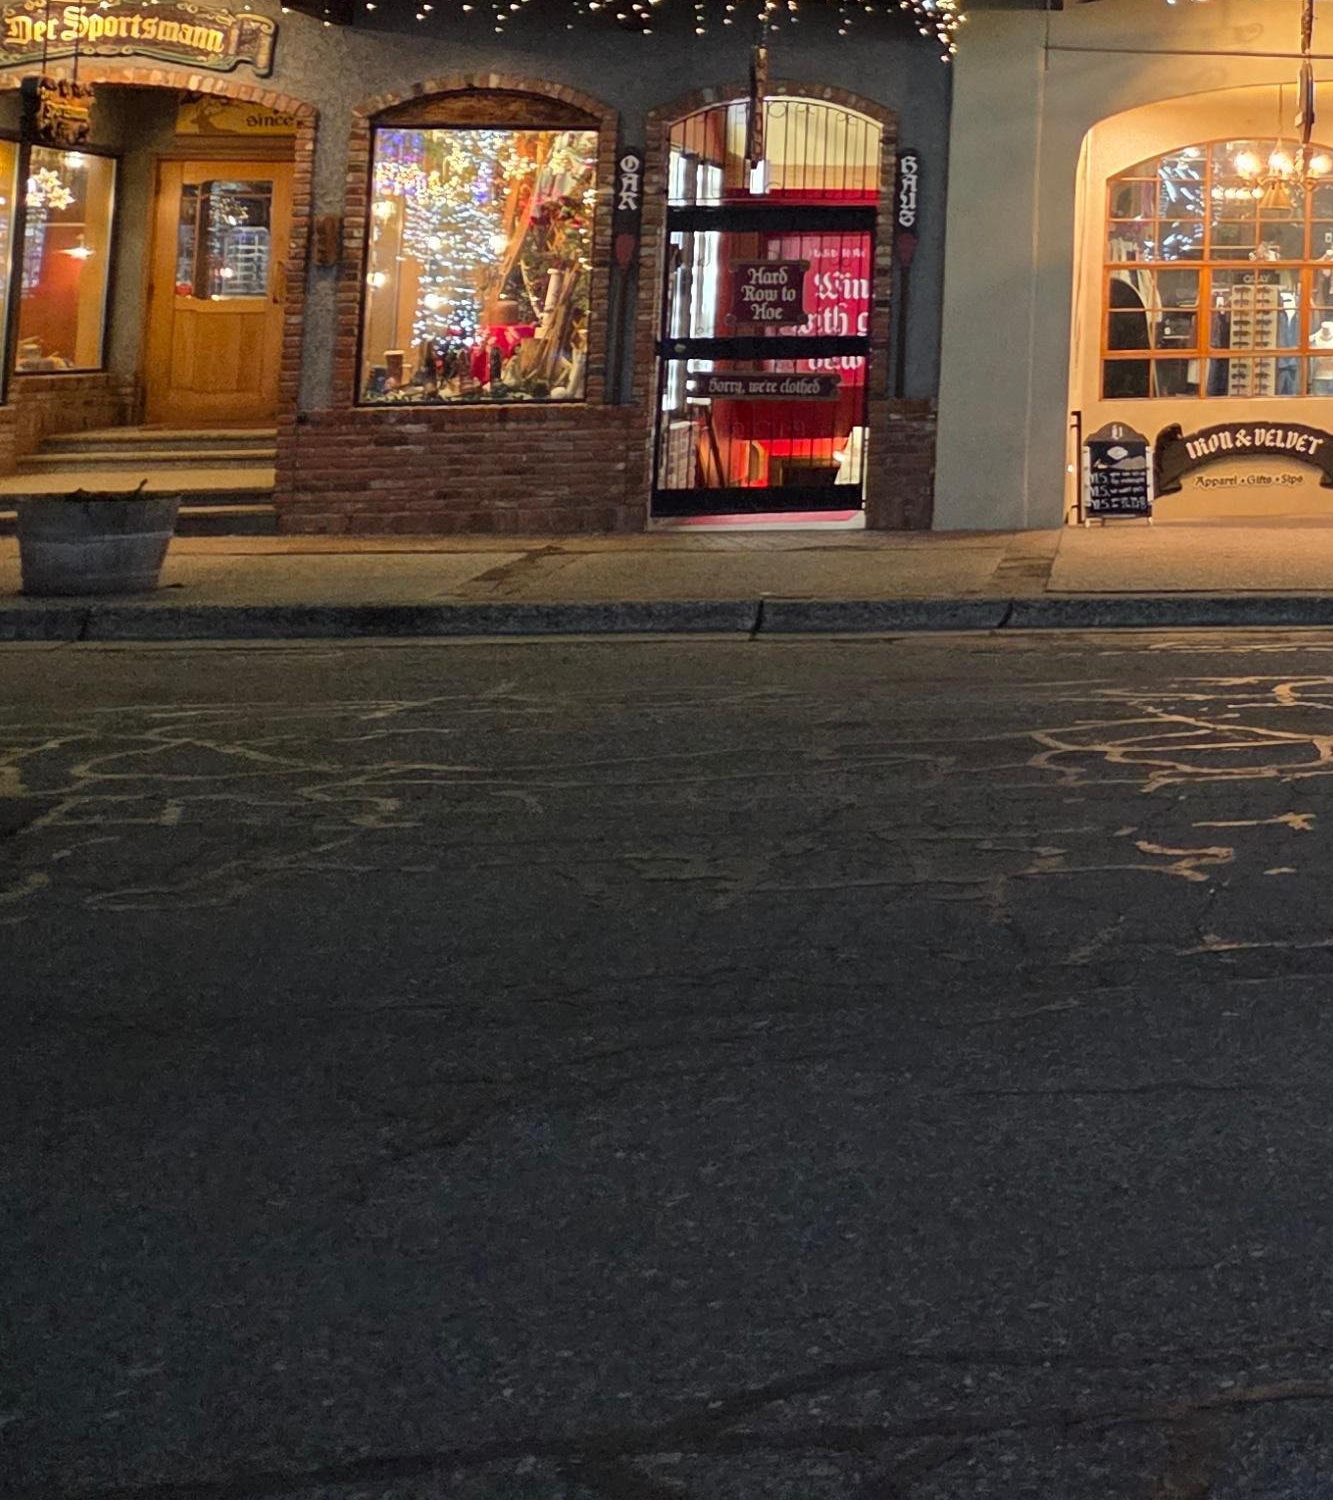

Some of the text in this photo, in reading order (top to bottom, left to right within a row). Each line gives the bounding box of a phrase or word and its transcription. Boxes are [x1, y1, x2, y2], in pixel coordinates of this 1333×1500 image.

[5, 5, 225, 53] Der Sportsmann
[747, 266, 789, 285] Hard
[740, 285, 797, 302] Row to
[750, 301, 784, 320] Hoe
[780, 377, 821, 394] clothed
[1235, 428, 1253, 448] &
[1253, 427, 1324, 456] VELVET
[1195, 475, 1238, 488] Apparel
[1246, 475, 1273, 485] Gifts
